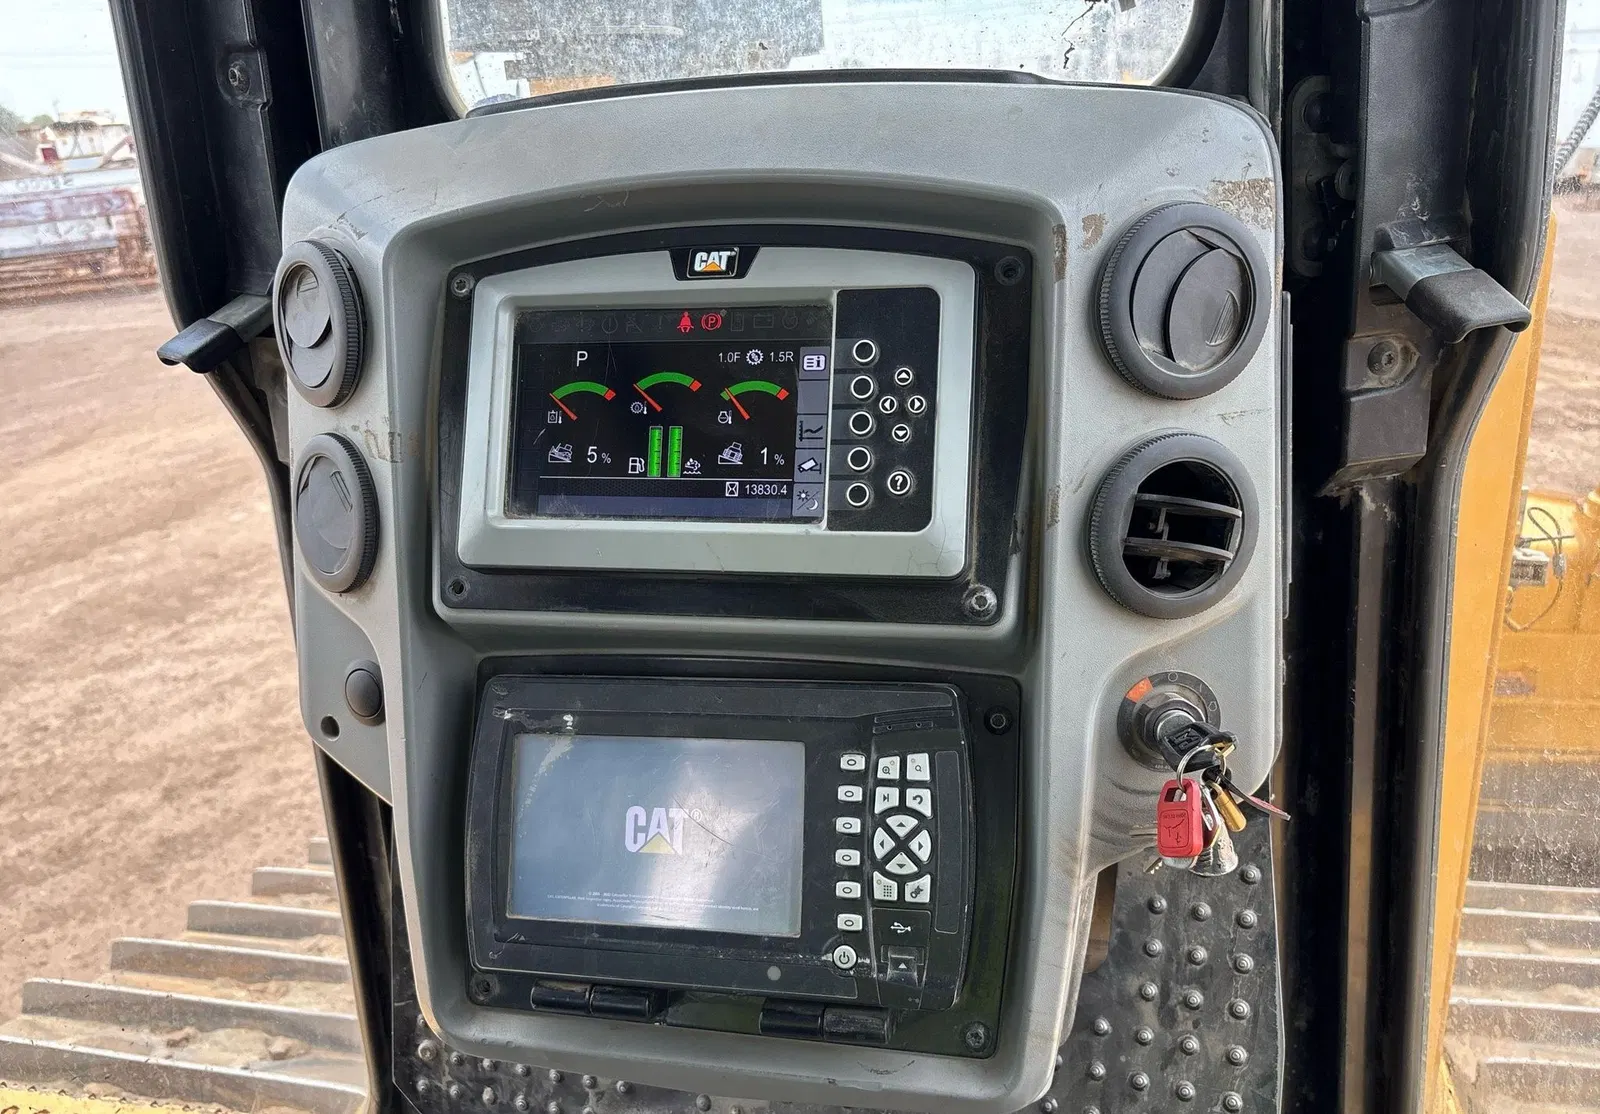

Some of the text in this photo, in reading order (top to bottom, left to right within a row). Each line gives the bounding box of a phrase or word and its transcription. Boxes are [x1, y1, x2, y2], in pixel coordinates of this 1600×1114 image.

[694, 251, 731, 272] CAT
[576, 350, 588, 367] P
[718, 351, 794, 363] 1.0F 1.5R
[586, 446, 612, 464] 5 %
[760, 447, 785, 466] 1 %
[744, 484, 788, 496] 13830.4
